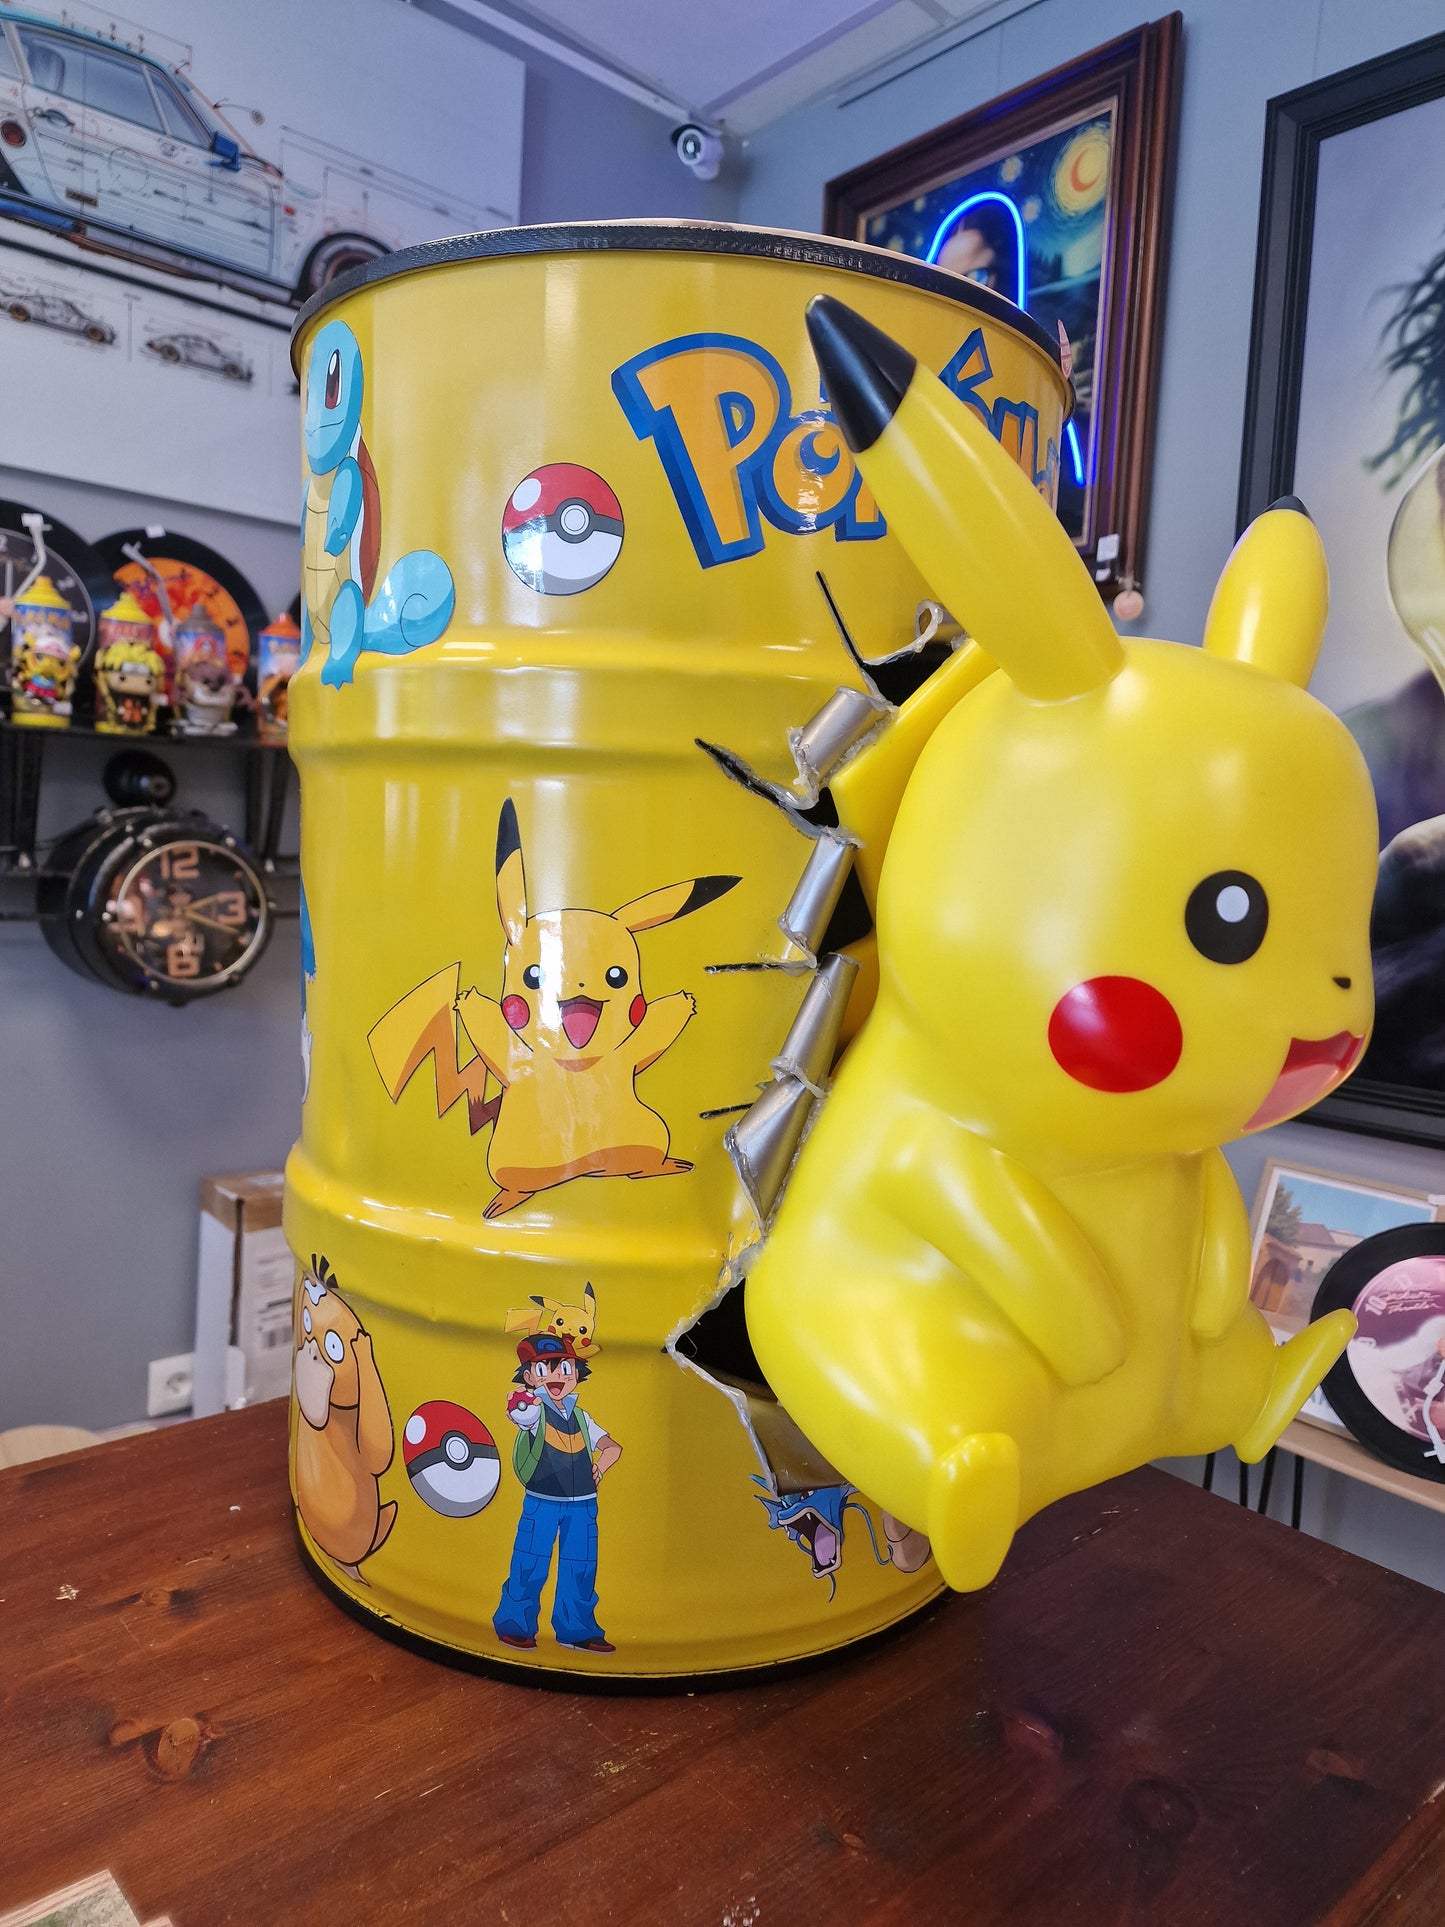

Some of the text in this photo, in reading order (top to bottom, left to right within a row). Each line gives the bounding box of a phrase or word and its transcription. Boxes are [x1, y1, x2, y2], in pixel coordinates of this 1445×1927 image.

[160, 847, 200, 879] 12
[215, 890, 247, 925] 3
[1364, 1295, 1388, 1316] 10
